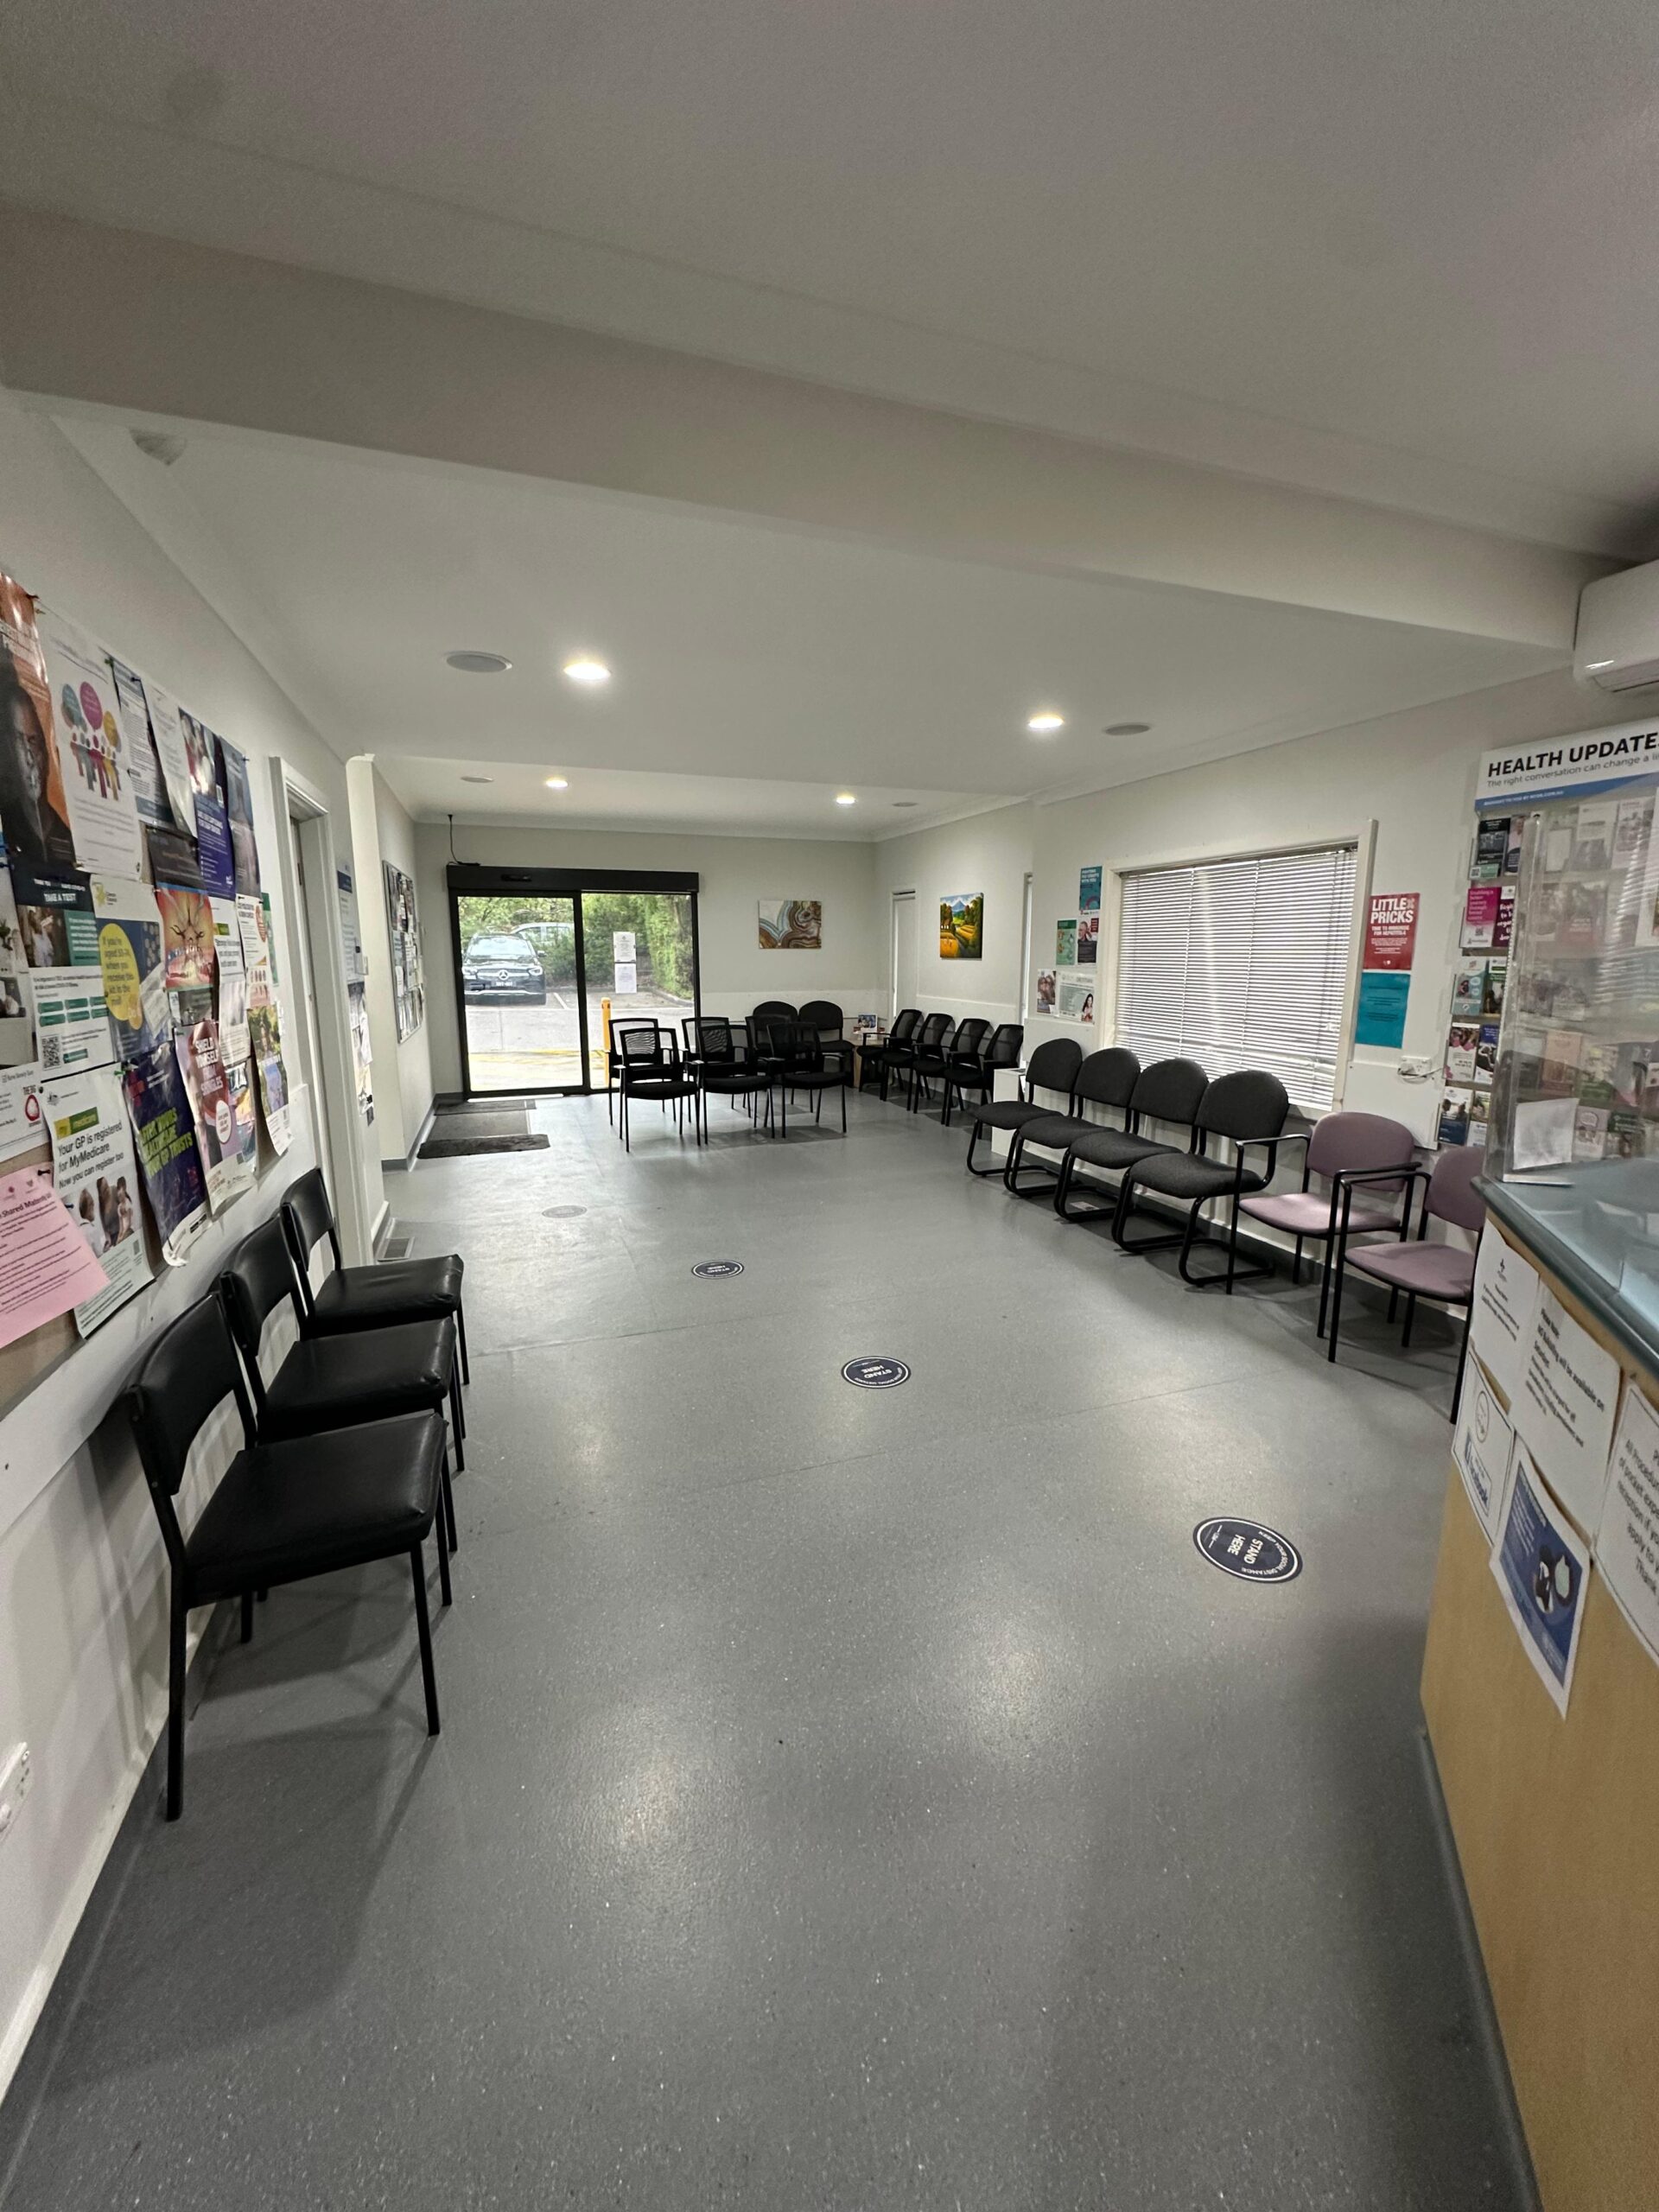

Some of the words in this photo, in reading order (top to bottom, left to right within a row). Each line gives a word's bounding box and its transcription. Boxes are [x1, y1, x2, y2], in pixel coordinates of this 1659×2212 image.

[1488, 750, 1563, 777] HEALTH
[1569, 733, 1659, 763] UPDATE
[1487, 779, 1502, 788] The
[1503, 775, 1523, 787] right
[1525, 766, 1581, 781] conversation
[1584, 764, 1601, 772] can
[1603, 756, 1640, 769] change
[62, 893, 76, 901] TEST
[1372, 898, 1408, 912] LITTLE
[1370, 910, 1414, 924] PRICKS
[58, 1142, 73, 1156] Your
[75, 1135, 85, 1149] GP
[86, 1134, 92, 1144] is
[94, 1121, 122, 1141] registered
[59, 1161, 68, 1173] for
[69, 1143, 110, 1167] MyMedicare
[59, 1178, 71, 1189] Now
[73, 1172, 83, 1185] you
[84, 1166, 94, 1176] can
[95, 1156, 115, 1171] register
[2, 1204, 24, 1217] Shared
[864, 1369, 893, 1379] STAND
[1567, 1363, 1573, 1377] be
[1573, 1373, 1597, 1402] available
[1597, 1399, 1605, 1413] on
[1625, 1439, 1634, 1455] All
[1633, 1448, 1659, 1491] Procedur
[1624, 1466, 1643, 1497] pocket
[1643, 1493, 1659, 1520] expe
[1618, 1480, 1643, 1524] reception
[1644, 1517, 1651, 1531] if
[1650, 1529, 1659, 1546] yo
[1227, 1534, 1246, 1555] HERE
[1243, 1538, 1263, 1565] STAND
[1627, 1522, 1646, 1553] apply
[1646, 1546, 1655, 1565] to
[1241, 1567, 1278, 1575] DISTANCE
[1278, 1556, 1288, 1572] SOCIAL
[1636, 1556, 1657, 1595] Thank
